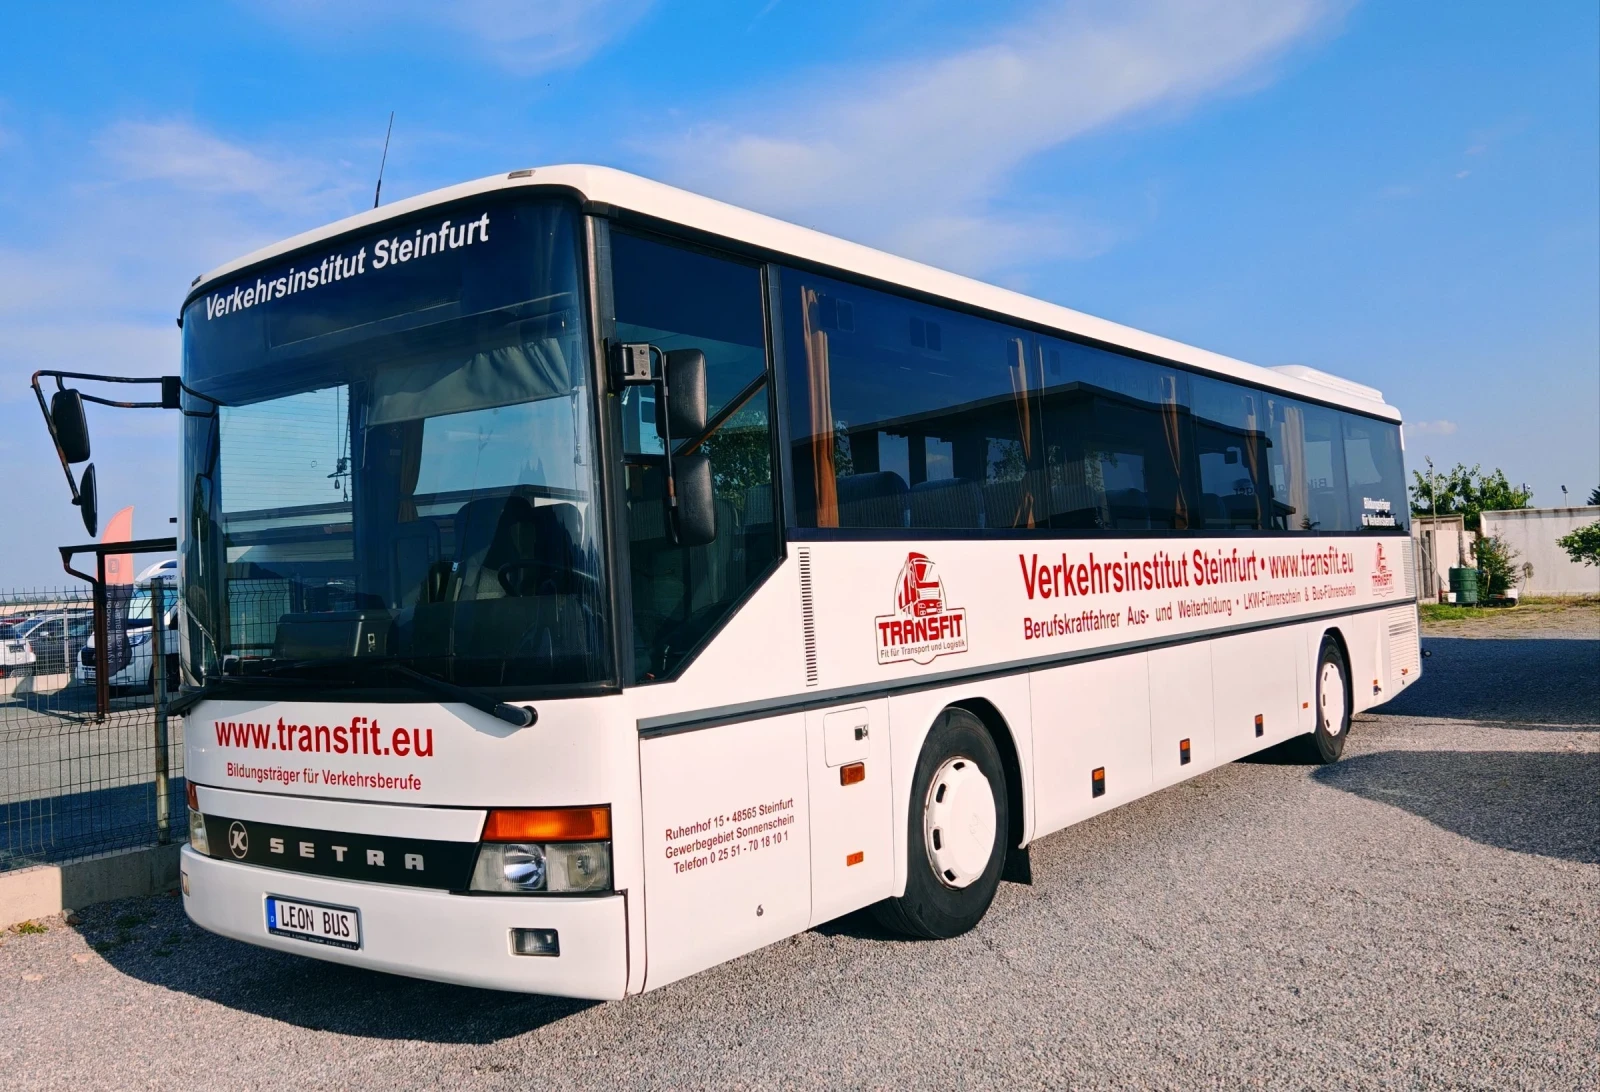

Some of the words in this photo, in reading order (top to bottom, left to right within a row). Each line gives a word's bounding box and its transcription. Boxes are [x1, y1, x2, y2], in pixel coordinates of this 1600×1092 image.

[205, 247, 366, 321] Verkehrsinstitut
[372, 212, 490, 270] Steinfurt
[1019, 551, 1189, 600] Verkehrsinstitut
[1193, 548, 1258, 586] Steinfurt
[1268, 546, 1354, 579] www.transfit.eu
[878, 614, 963, 647] TRANSFIT
[1023, 609, 1121, 640] Berufskraftfahrer
[1127, 606, 1150, 626] Aus-
[1156, 602, 1173, 622] und
[1177, 596, 1232, 619] Weiterbildung
[1243, 588, 1301, 610] LKW-Führerschein
[1304, 586, 1309, 601] &
[1312, 582, 1356, 601] Bus-Führerschein
[880, 649, 889, 658] Fit
[891, 648, 900, 656] für
[901, 645, 930, 655] Transport
[931, 642, 942, 651] und
[943, 639, 965, 650] Logistik
[215, 716, 433, 757] www.transfit.eu
[227, 763, 300, 786] Bildungsträger
[303, 768, 319, 784] für
[322, 770, 421, 790] Verkehrsberufe
[665, 818, 712, 841] Ruhenhof
[714, 815, 724, 828] 15
[732, 806, 757, 823] 48565
[759, 797, 794, 816] Steinfurt
[665, 830, 734, 859] Gewerbegebiet
[736, 814, 795, 839] Sonnenschein
[270, 837, 425, 871] SETRA
[674, 856, 708, 874] Telefon
[710, 851, 716, 863] 0
[718, 849, 729, 861] 25
[731, 844, 741, 857] 51
[749, 839, 758, 852] 70
[761, 835, 770, 848] 18
[773, 832, 782, 844] 10
[784, 830, 788, 841] 1
[281, 904, 314, 932] LEON
[322, 911, 350, 937] BUS
